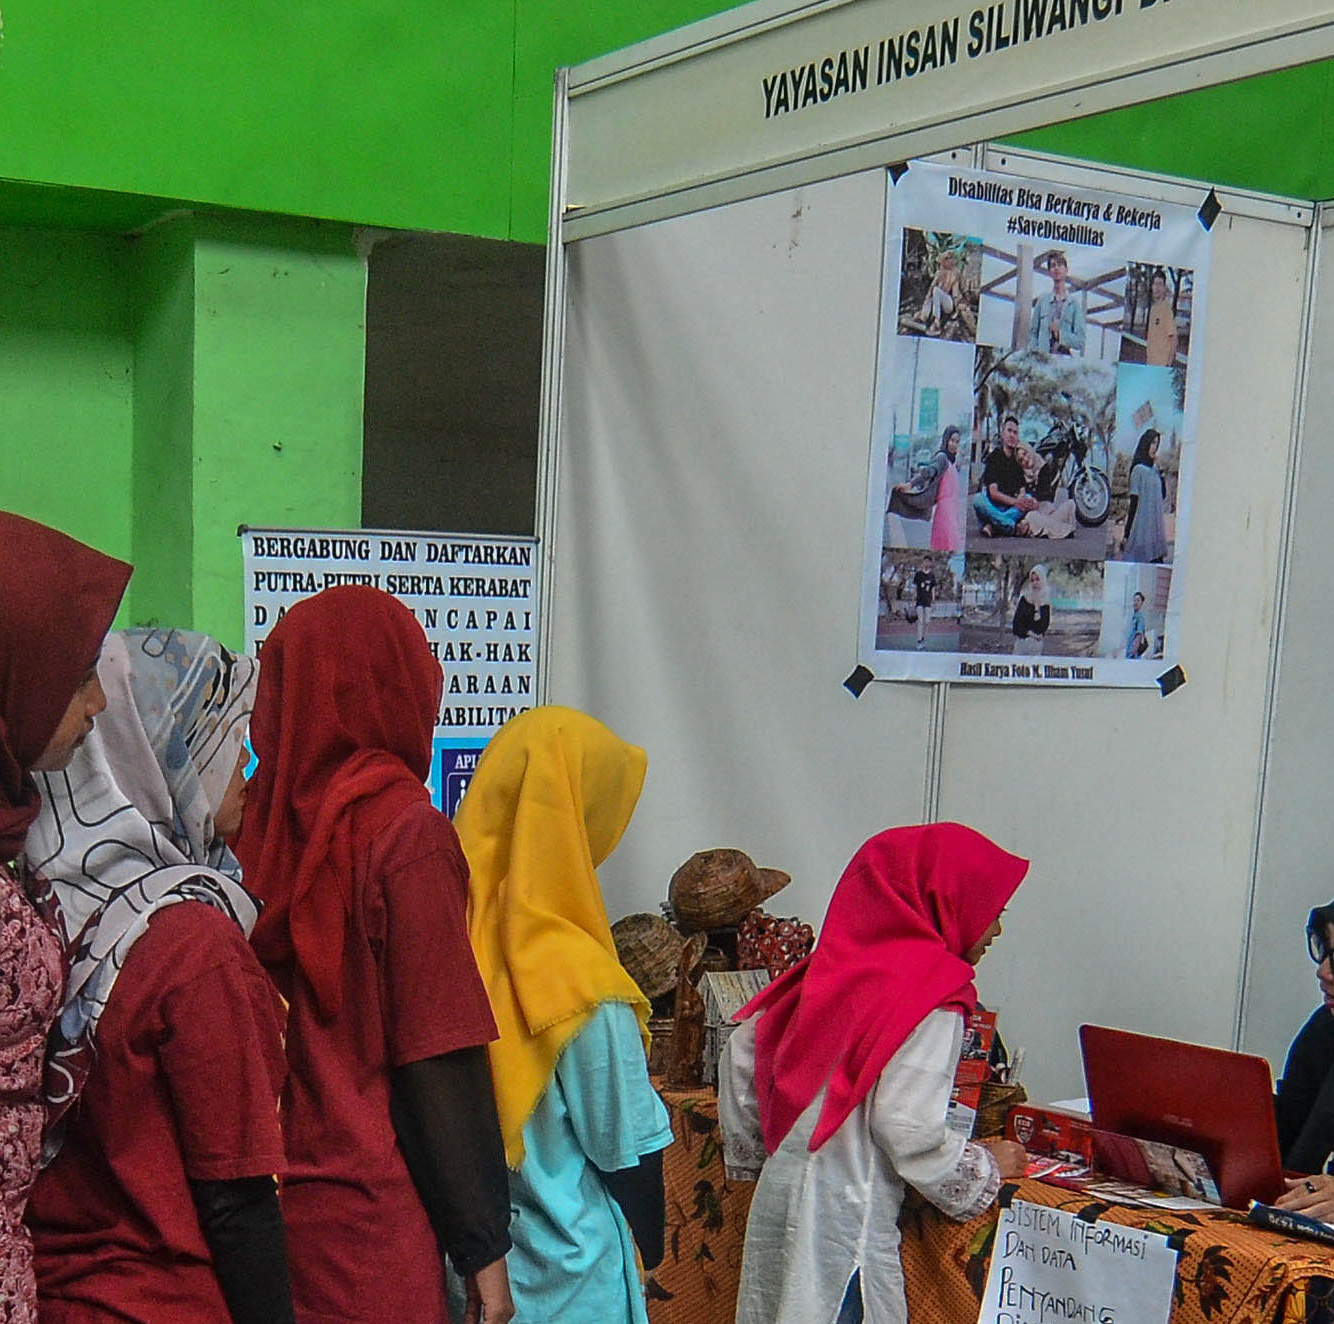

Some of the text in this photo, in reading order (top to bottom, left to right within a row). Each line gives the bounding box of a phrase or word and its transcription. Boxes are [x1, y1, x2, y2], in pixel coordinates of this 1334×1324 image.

[763, 0, 1124, 119] YAYASAN INSAN SILIWAN
[948, 176, 1161, 231] Disabilitas Bisa Berkarya & Bekerja
[1007, 216, 1105, 247] #SaveDisabilitas
[252, 536, 532, 567] BERGABUNG DAN DAFTARKAN
[386, 575, 446, 597] SERTA
[449, 577, 532, 599] KERABAT
